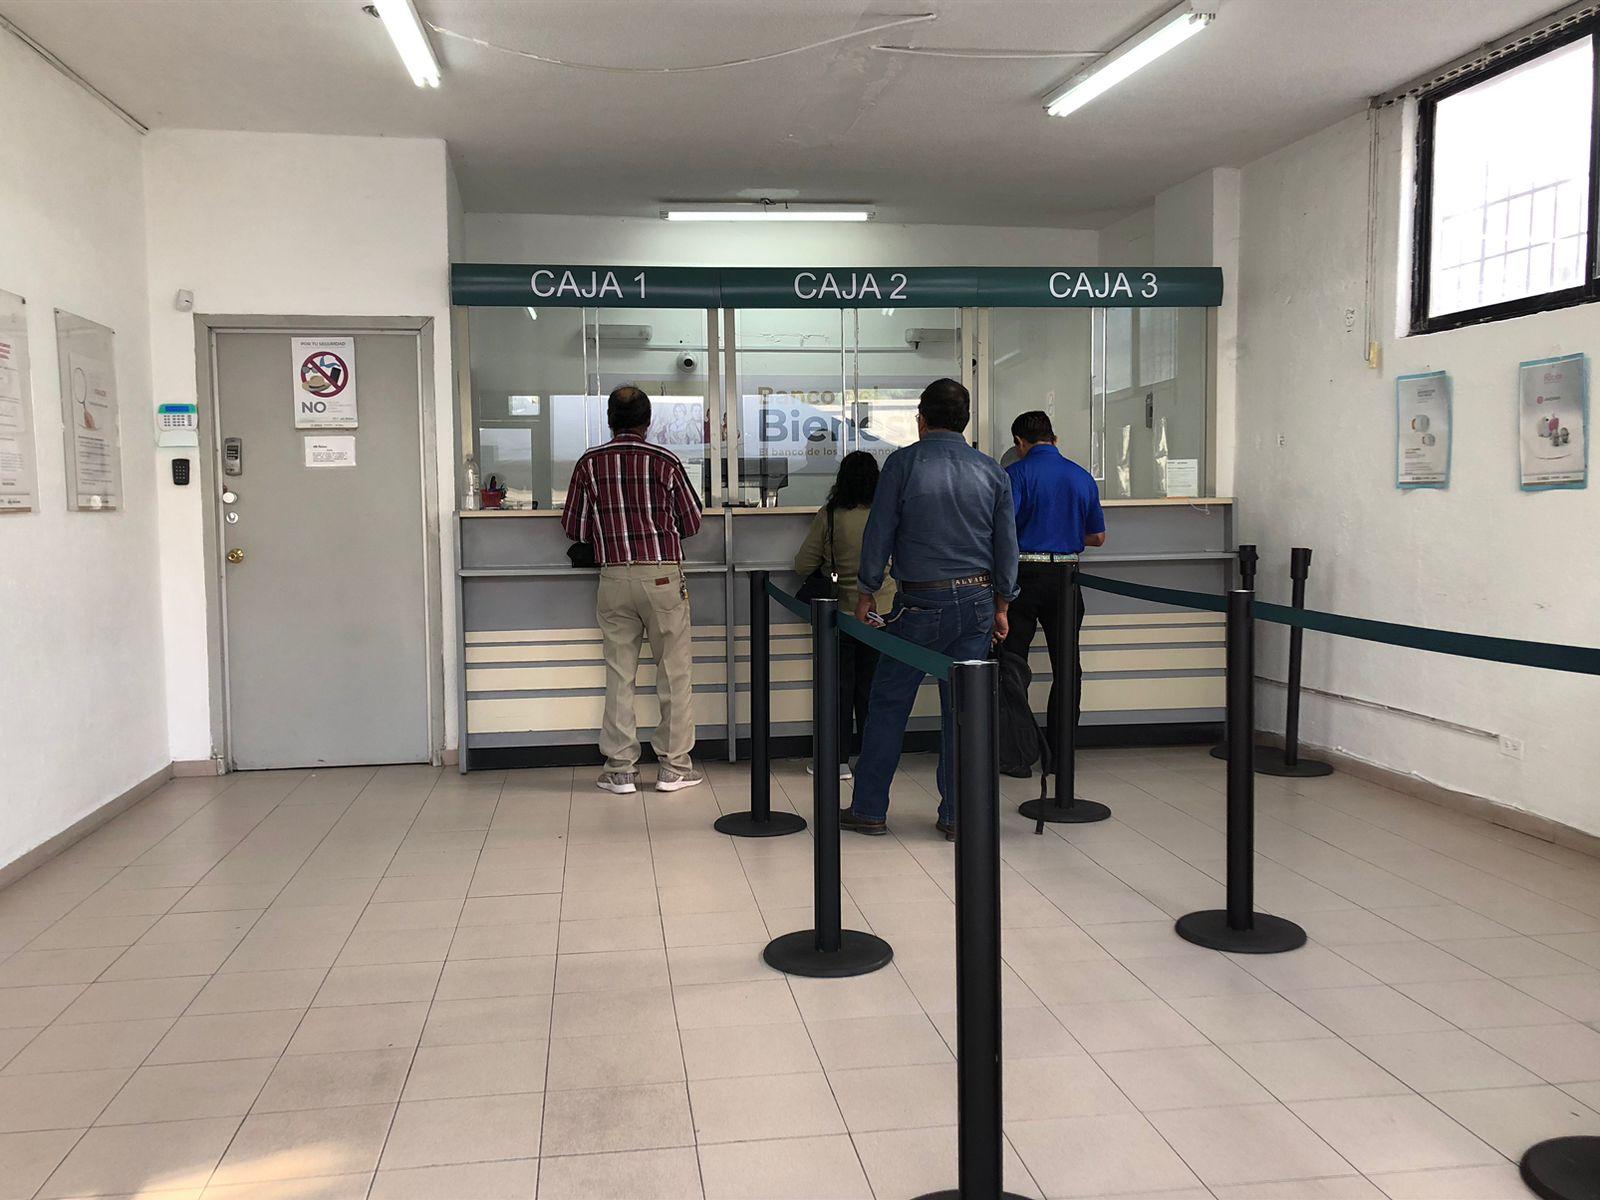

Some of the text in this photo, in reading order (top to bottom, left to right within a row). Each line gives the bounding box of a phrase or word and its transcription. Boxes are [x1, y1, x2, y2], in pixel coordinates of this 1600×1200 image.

[531, 269, 646, 299] CAJA 1
[794, 272, 907, 300] CAJA 2
[1049, 271, 1158, 298] CAJA 3
[302, 401, 326, 413] NO
[758, 386, 835, 405] Banco
[771, 448, 803, 456] banco
[807, 448, 819, 456] de
[823, 448, 837, 456] los
